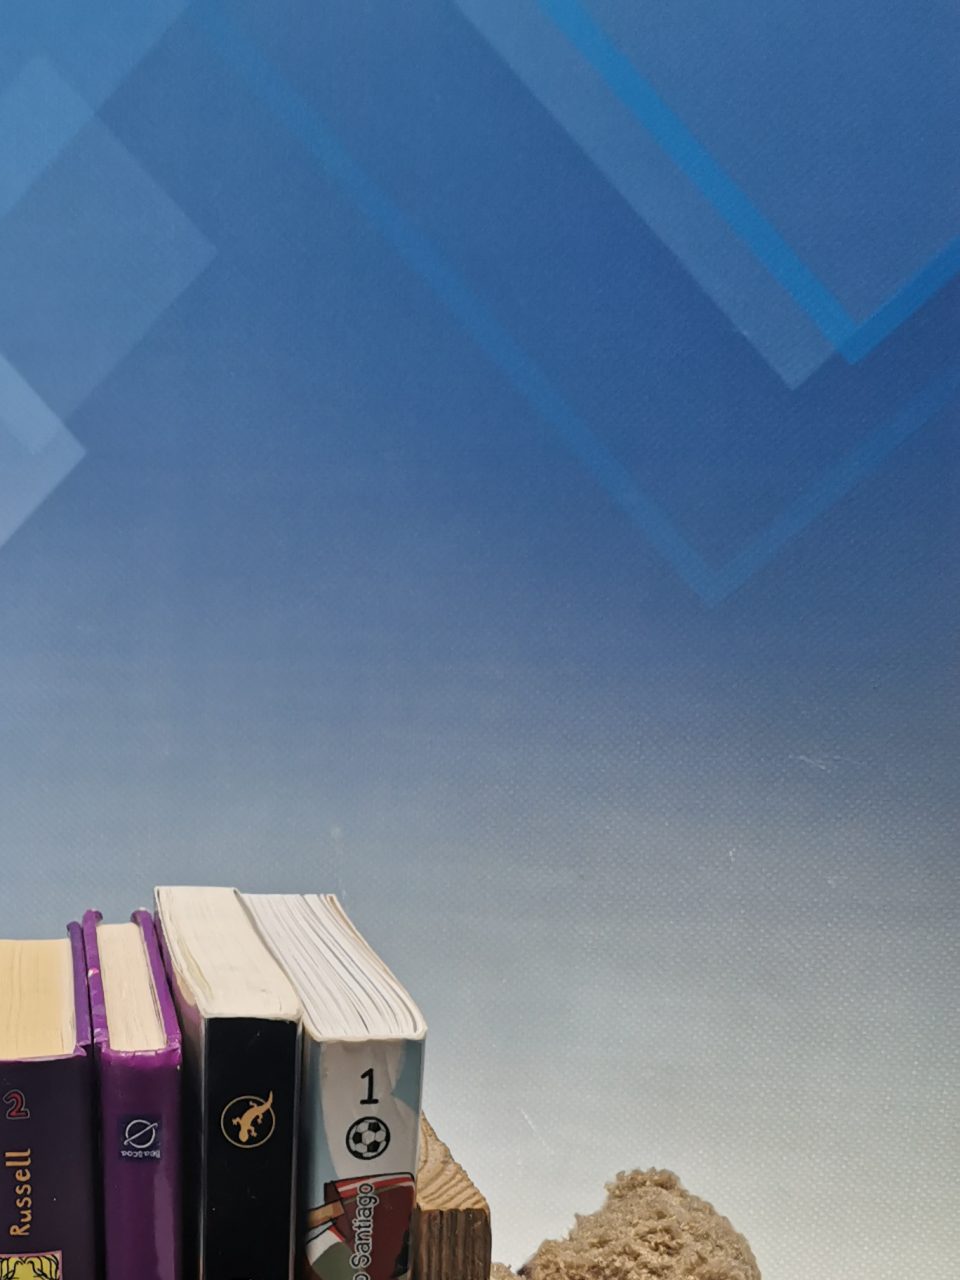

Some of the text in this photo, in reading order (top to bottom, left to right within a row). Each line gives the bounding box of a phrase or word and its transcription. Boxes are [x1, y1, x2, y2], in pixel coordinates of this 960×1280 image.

[3, 1089, 30, 1120] 2
[360, 1067, 379, 1104] 1
[5, 1148, 32, 1236] Russell
[350, 1182, 379, 1269] Santiago
